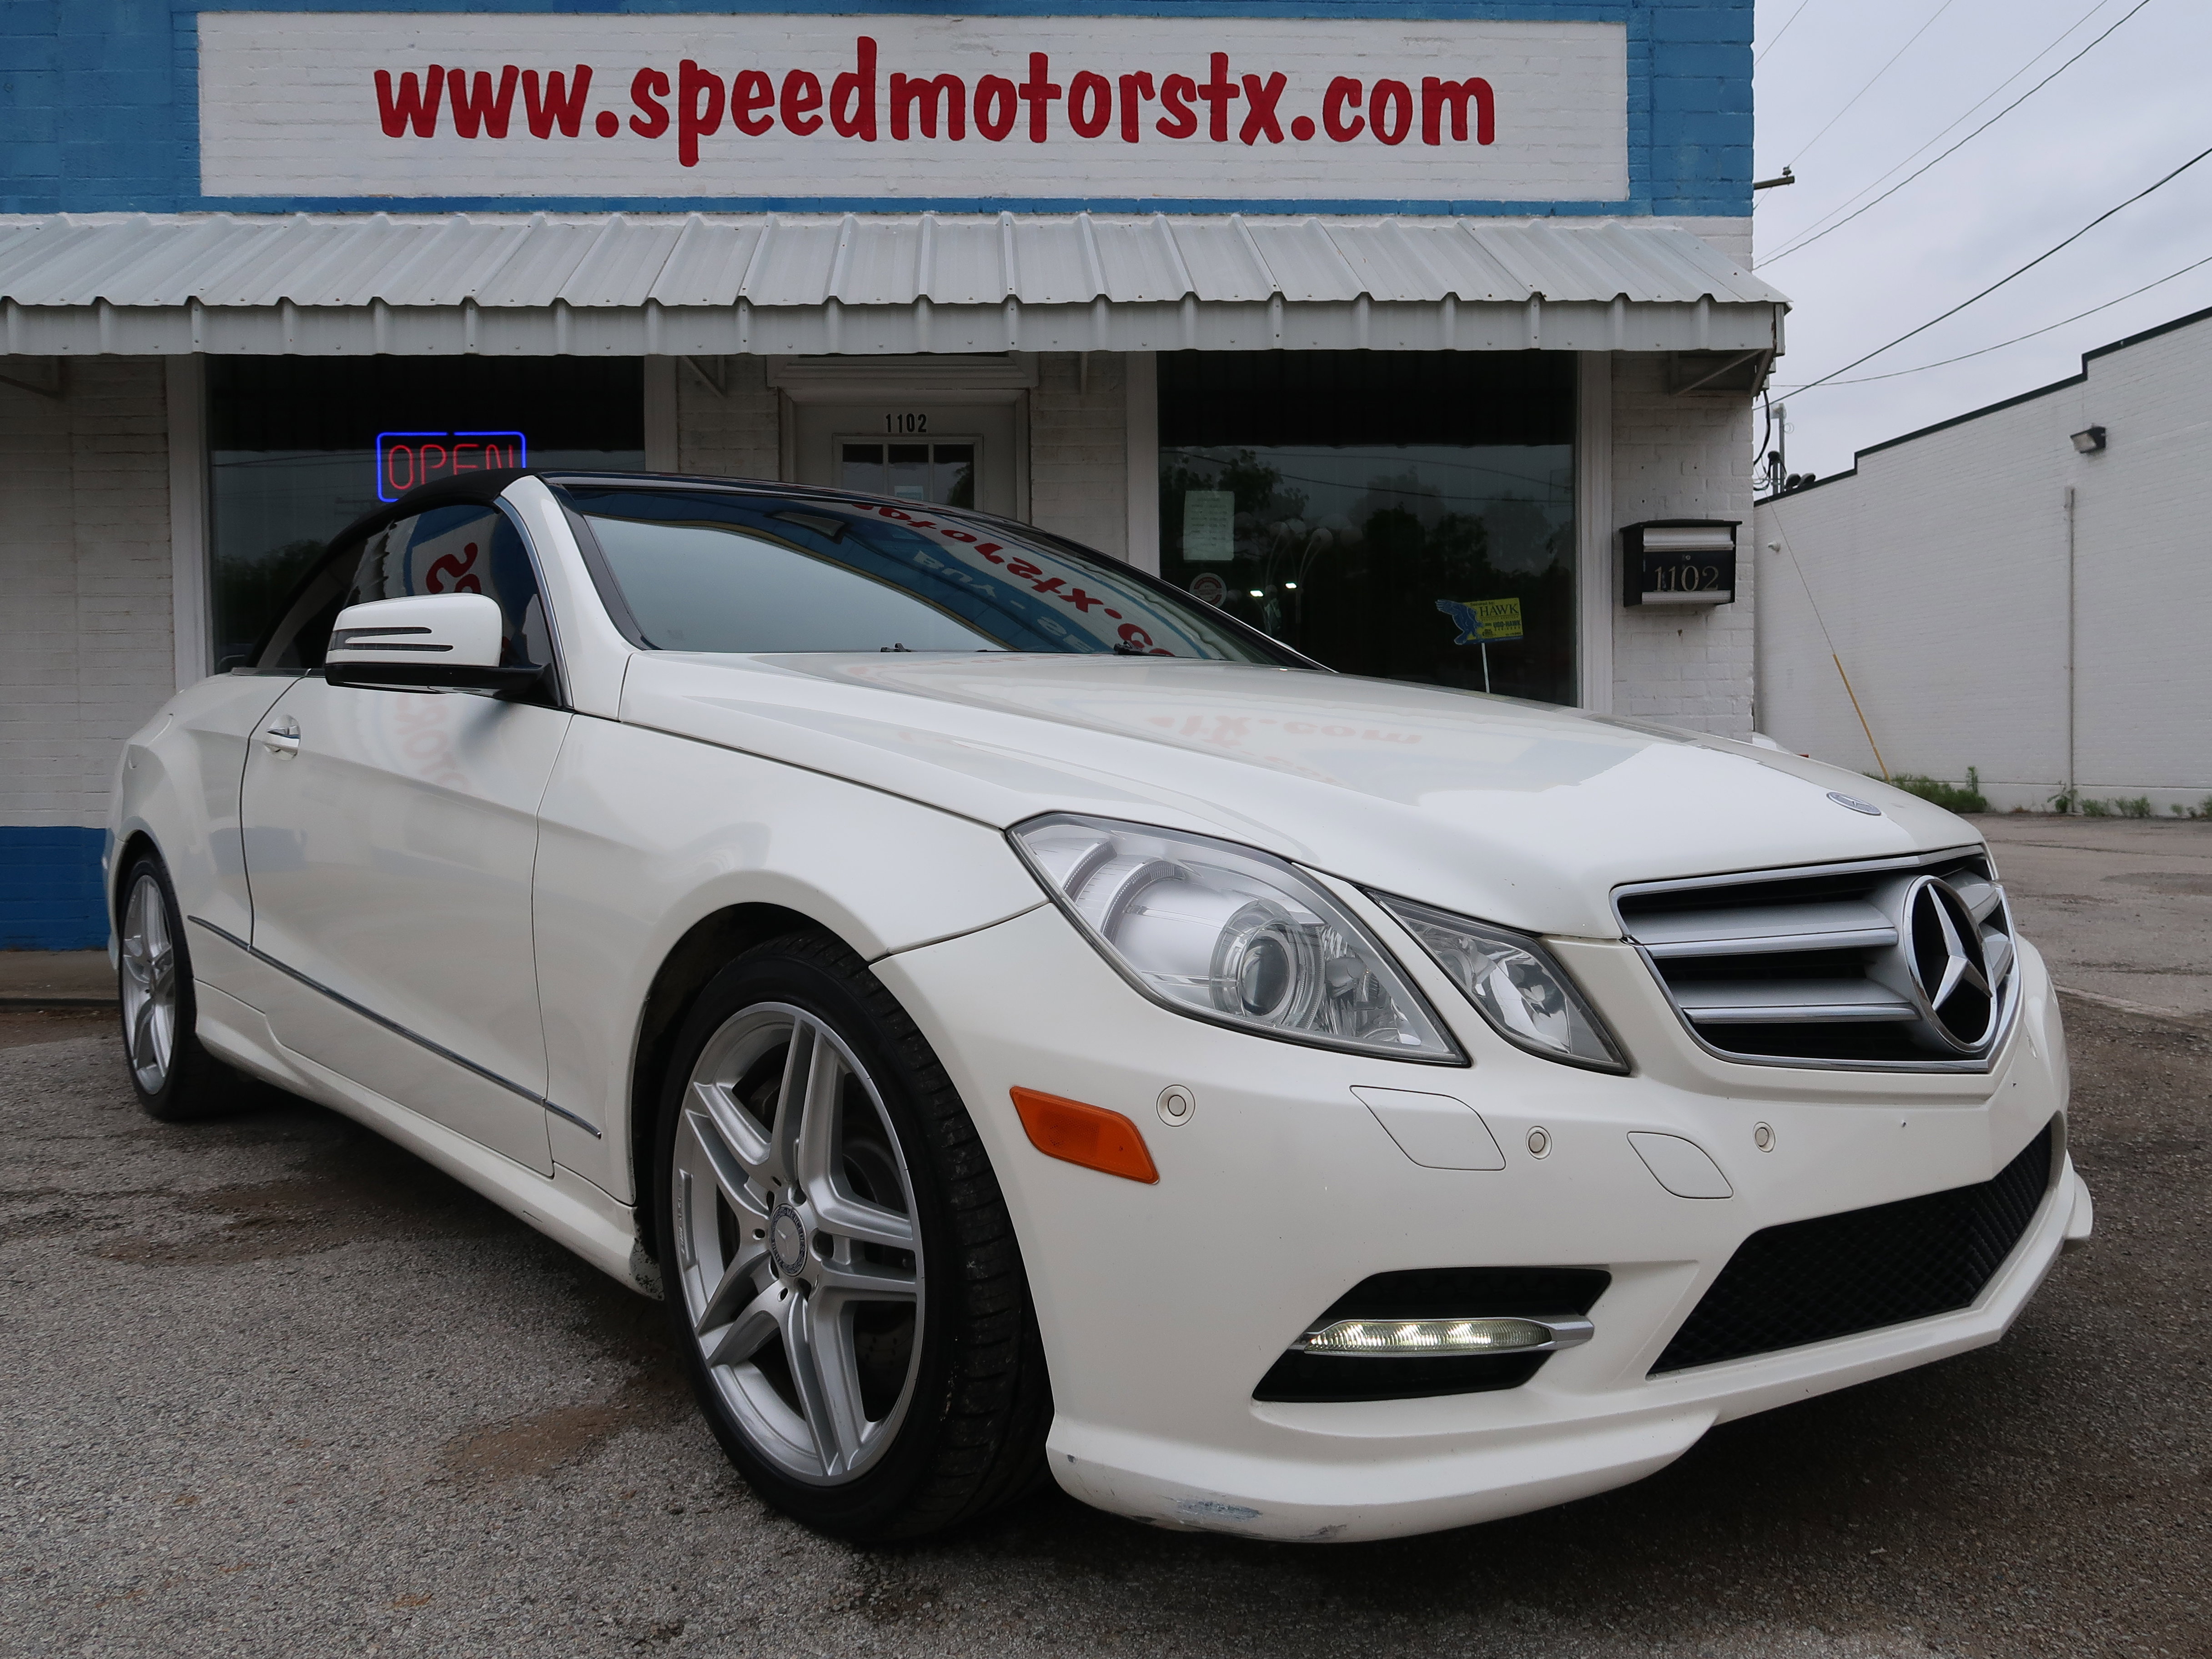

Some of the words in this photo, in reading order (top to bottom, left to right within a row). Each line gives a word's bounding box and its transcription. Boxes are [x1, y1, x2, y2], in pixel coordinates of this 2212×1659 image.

[374, 36, 1494, 166] www.speedmotorstx.com
[885, 413, 927, 433] 1102
[1654, 566, 1719, 592] 1102
[1480, 603, 1519, 617] HAWK
